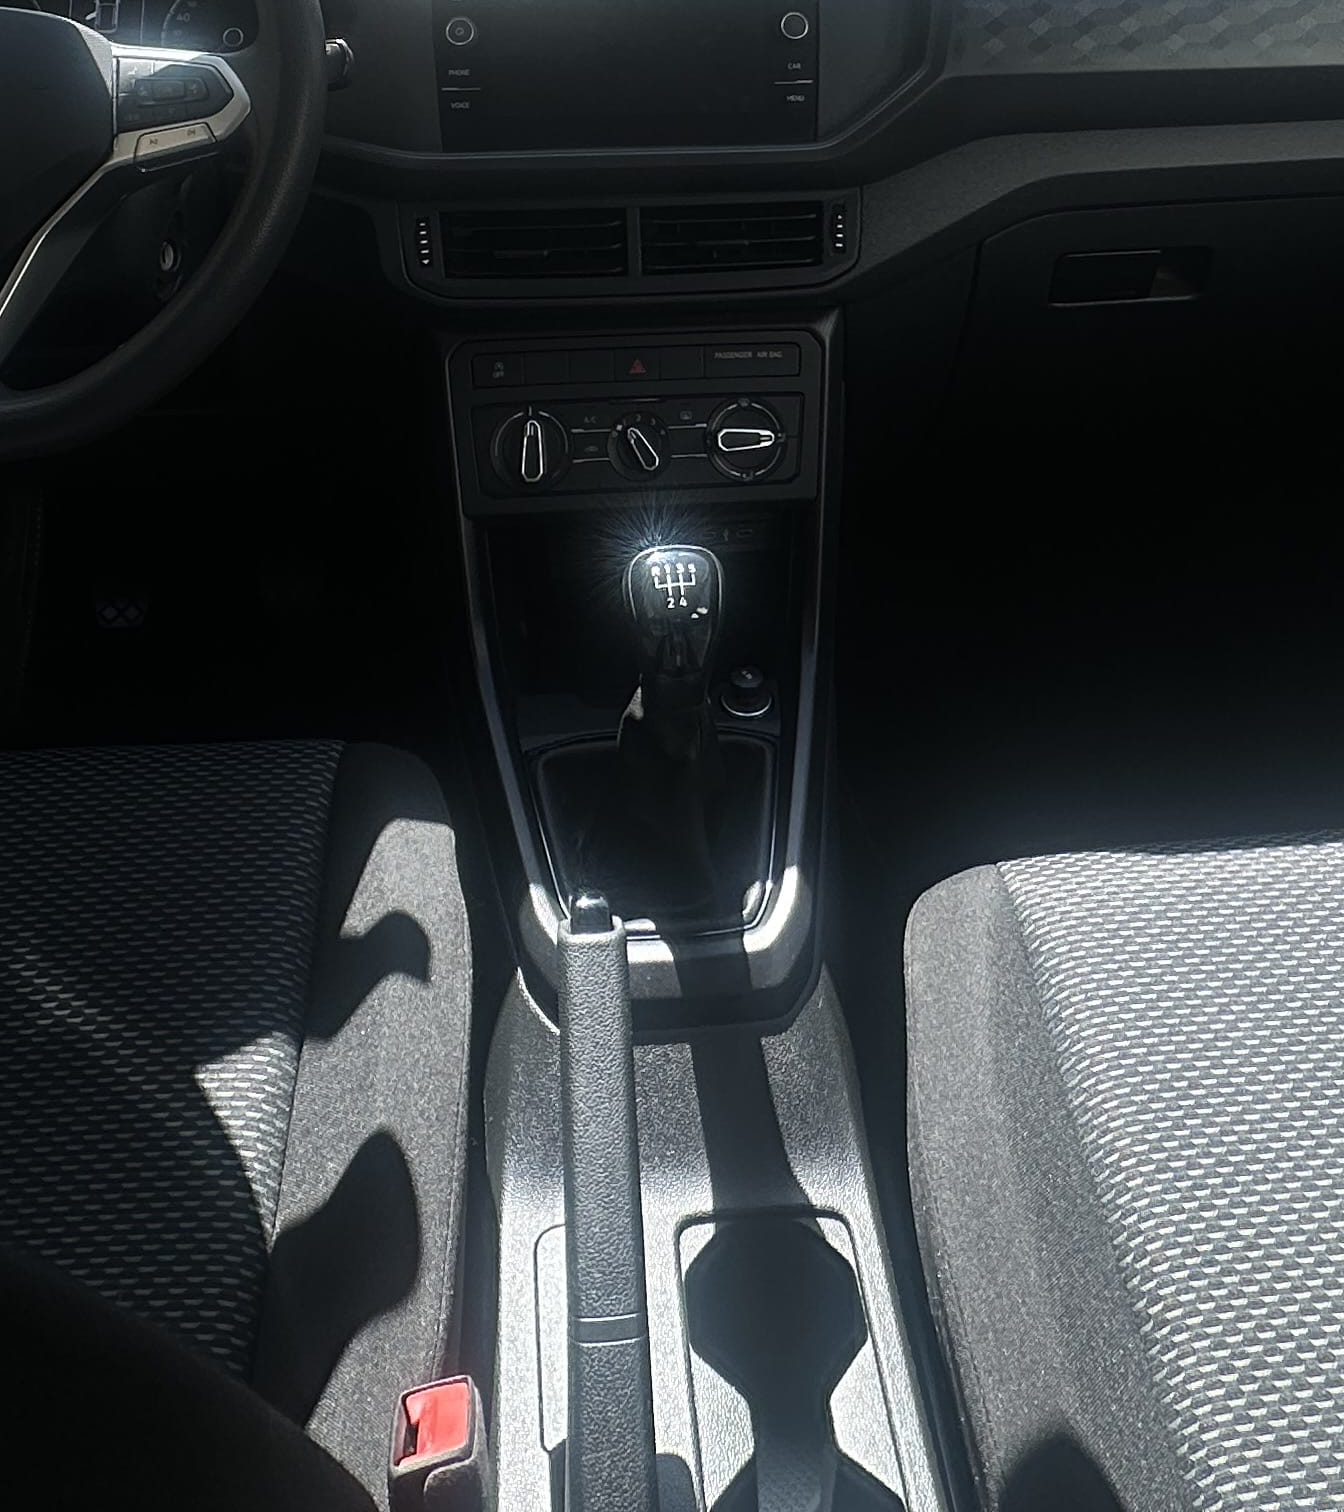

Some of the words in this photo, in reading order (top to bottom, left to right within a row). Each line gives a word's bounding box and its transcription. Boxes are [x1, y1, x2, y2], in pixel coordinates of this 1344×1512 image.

[651, 565, 661, 576] R
[663, 563, 671, 573] 1
[676, 563, 685, 573] 3
[687, 563, 696, 573] 5
[666, 597, 675, 608] 2
[679, 597, 688, 607] 4
